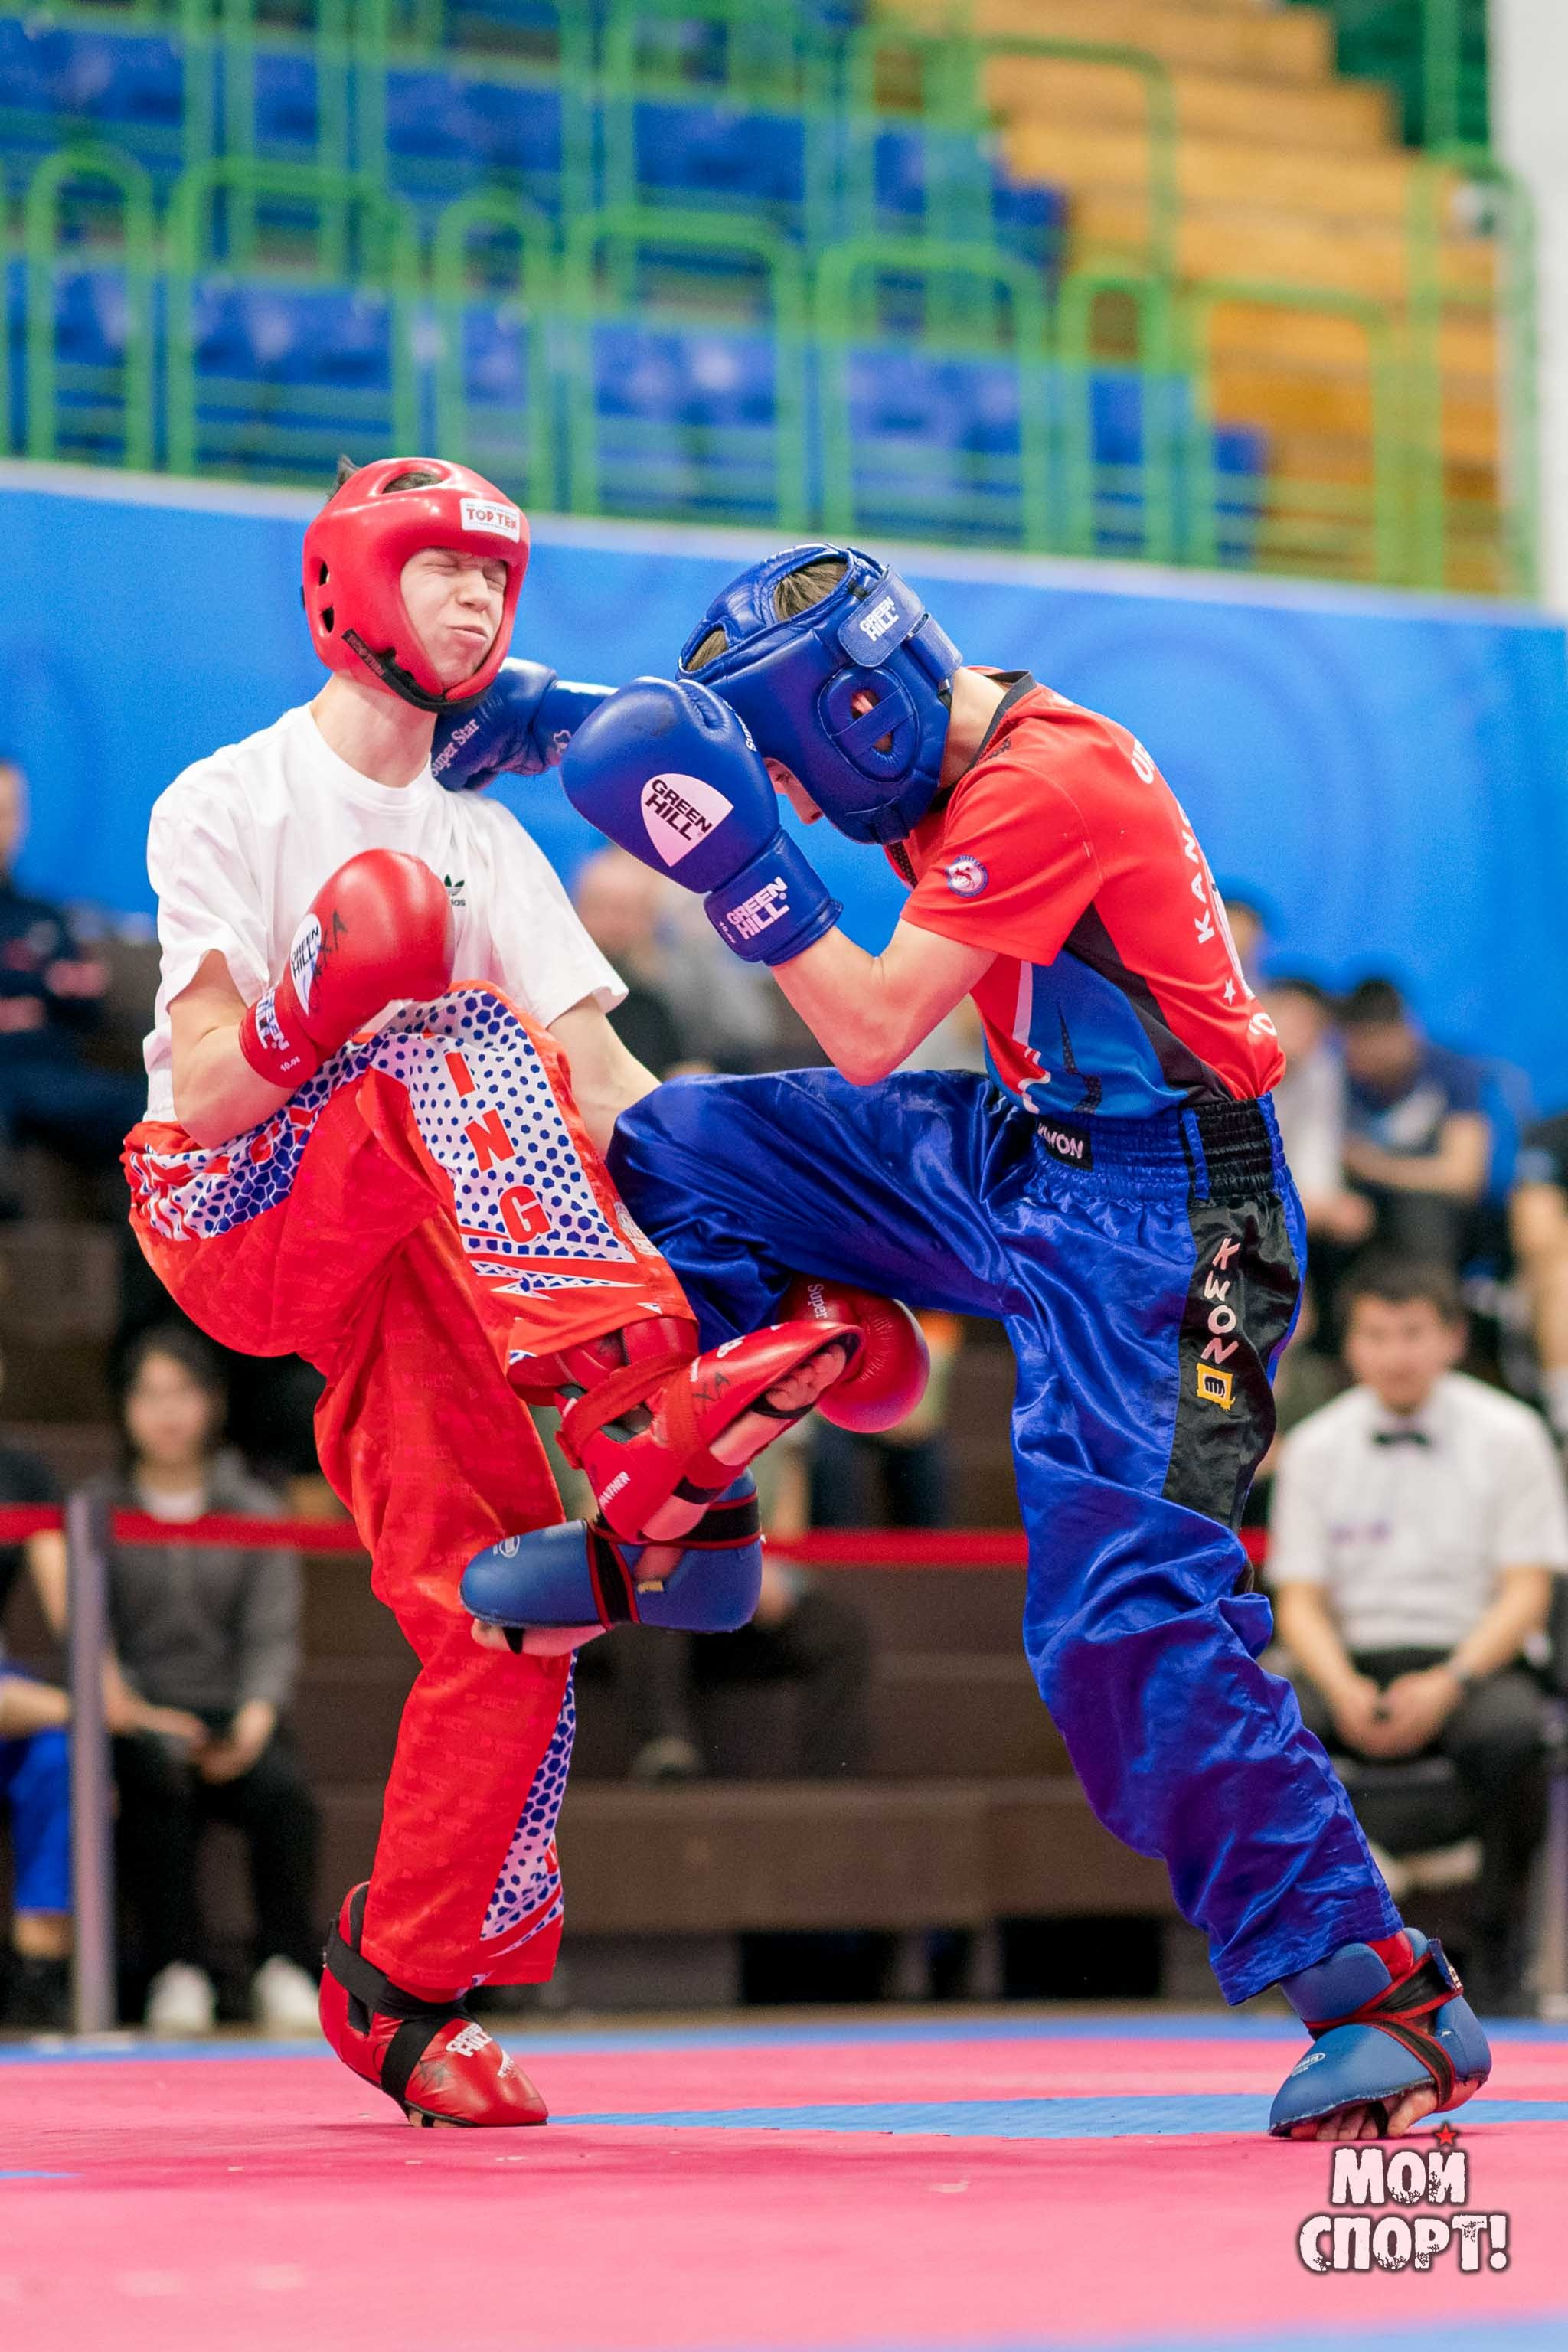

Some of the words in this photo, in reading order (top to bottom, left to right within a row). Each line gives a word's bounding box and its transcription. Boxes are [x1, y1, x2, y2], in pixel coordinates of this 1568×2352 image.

[466, 508, 494, 523] TOP
[859, 596, 895, 632] GREEN
[866, 611, 900, 642] HILL
[451, 718, 479, 745] Star
[645, 793, 691, 841] HILL
[652, 779, 712, 833] GREEN
[727, 876, 788, 926] GREEN
[736, 902, 790, 940] HILL
[292, 944, 315, 980] HILL
[808, 1283, 828, 1319] Super
[1204, 1237, 1241, 1364] KWON
